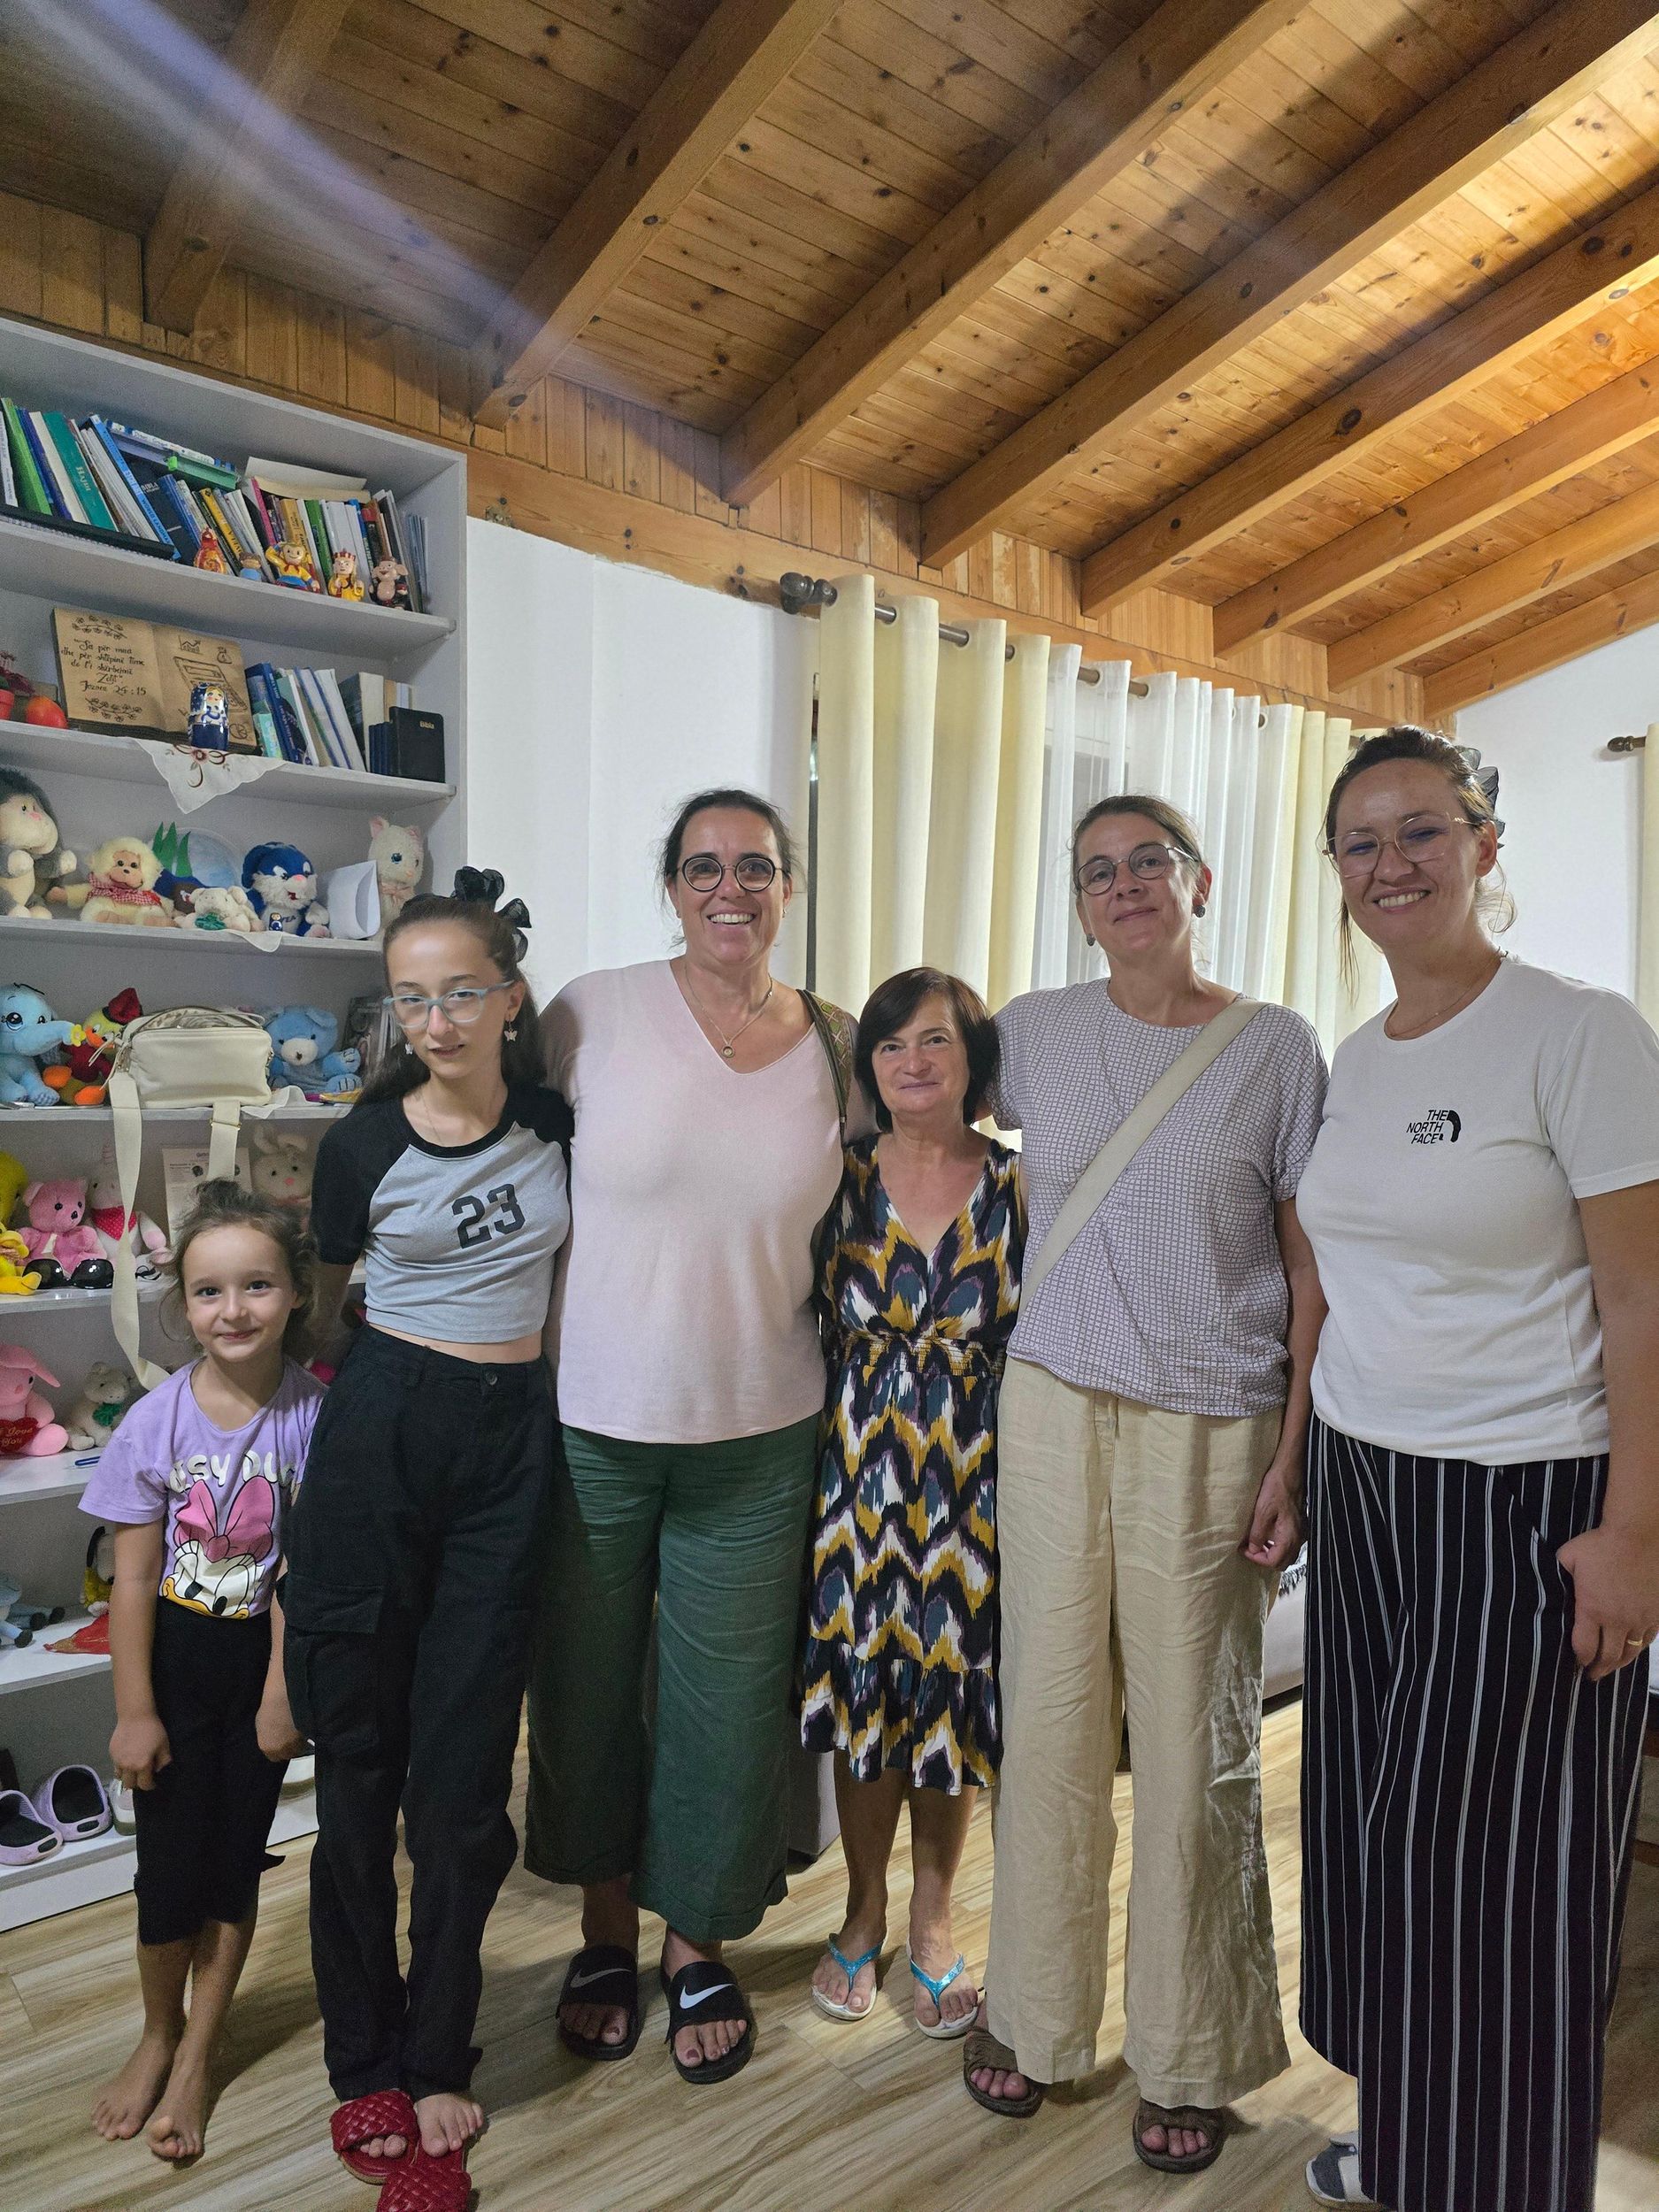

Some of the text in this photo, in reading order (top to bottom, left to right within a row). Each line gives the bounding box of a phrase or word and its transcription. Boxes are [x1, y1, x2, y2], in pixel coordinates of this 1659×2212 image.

[152, 518, 171, 544] LANDMA
[1427, 1110, 1448, 1121] THE
[1406, 1122, 1444, 1133] NORTH
[1411, 1133, 1439, 1144] FACE
[451, 1184, 526, 1248] 23
